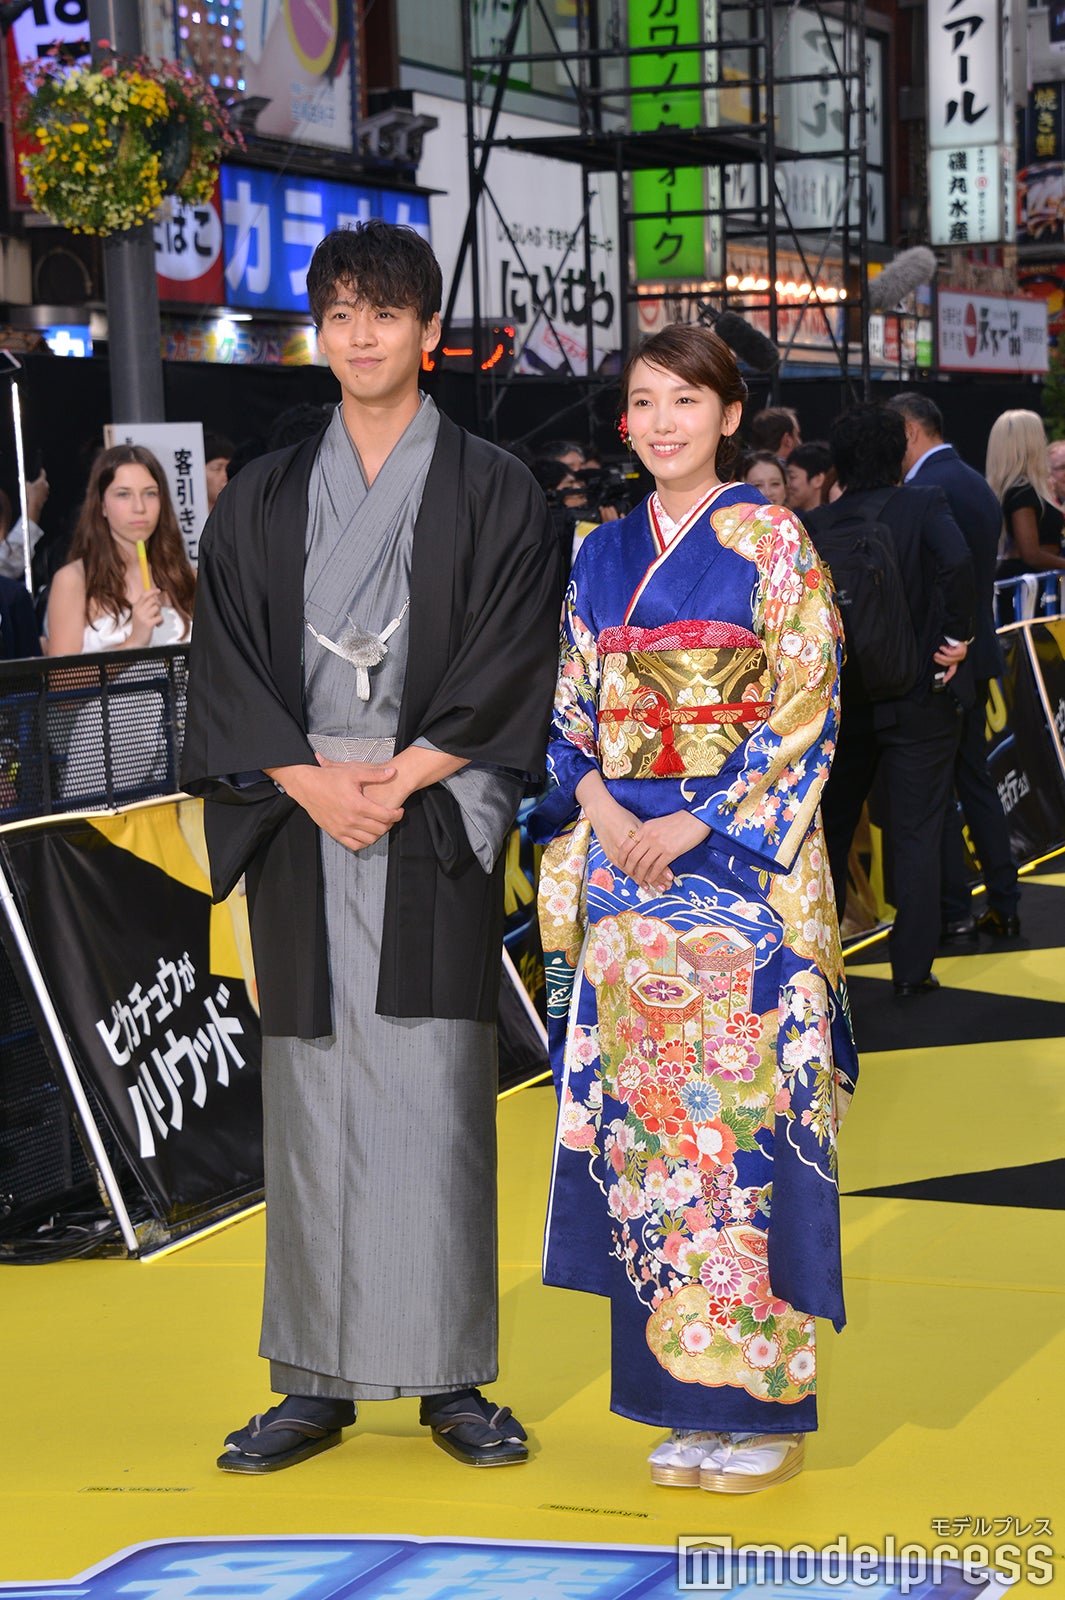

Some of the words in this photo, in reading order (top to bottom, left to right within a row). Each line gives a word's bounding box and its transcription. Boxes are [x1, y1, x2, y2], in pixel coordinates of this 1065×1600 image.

[948, 151, 968, 243] 磯丸水産
[95, 951, 196, 1067] ピカチュウが
[128, 982, 246, 1159] ハリウッド
